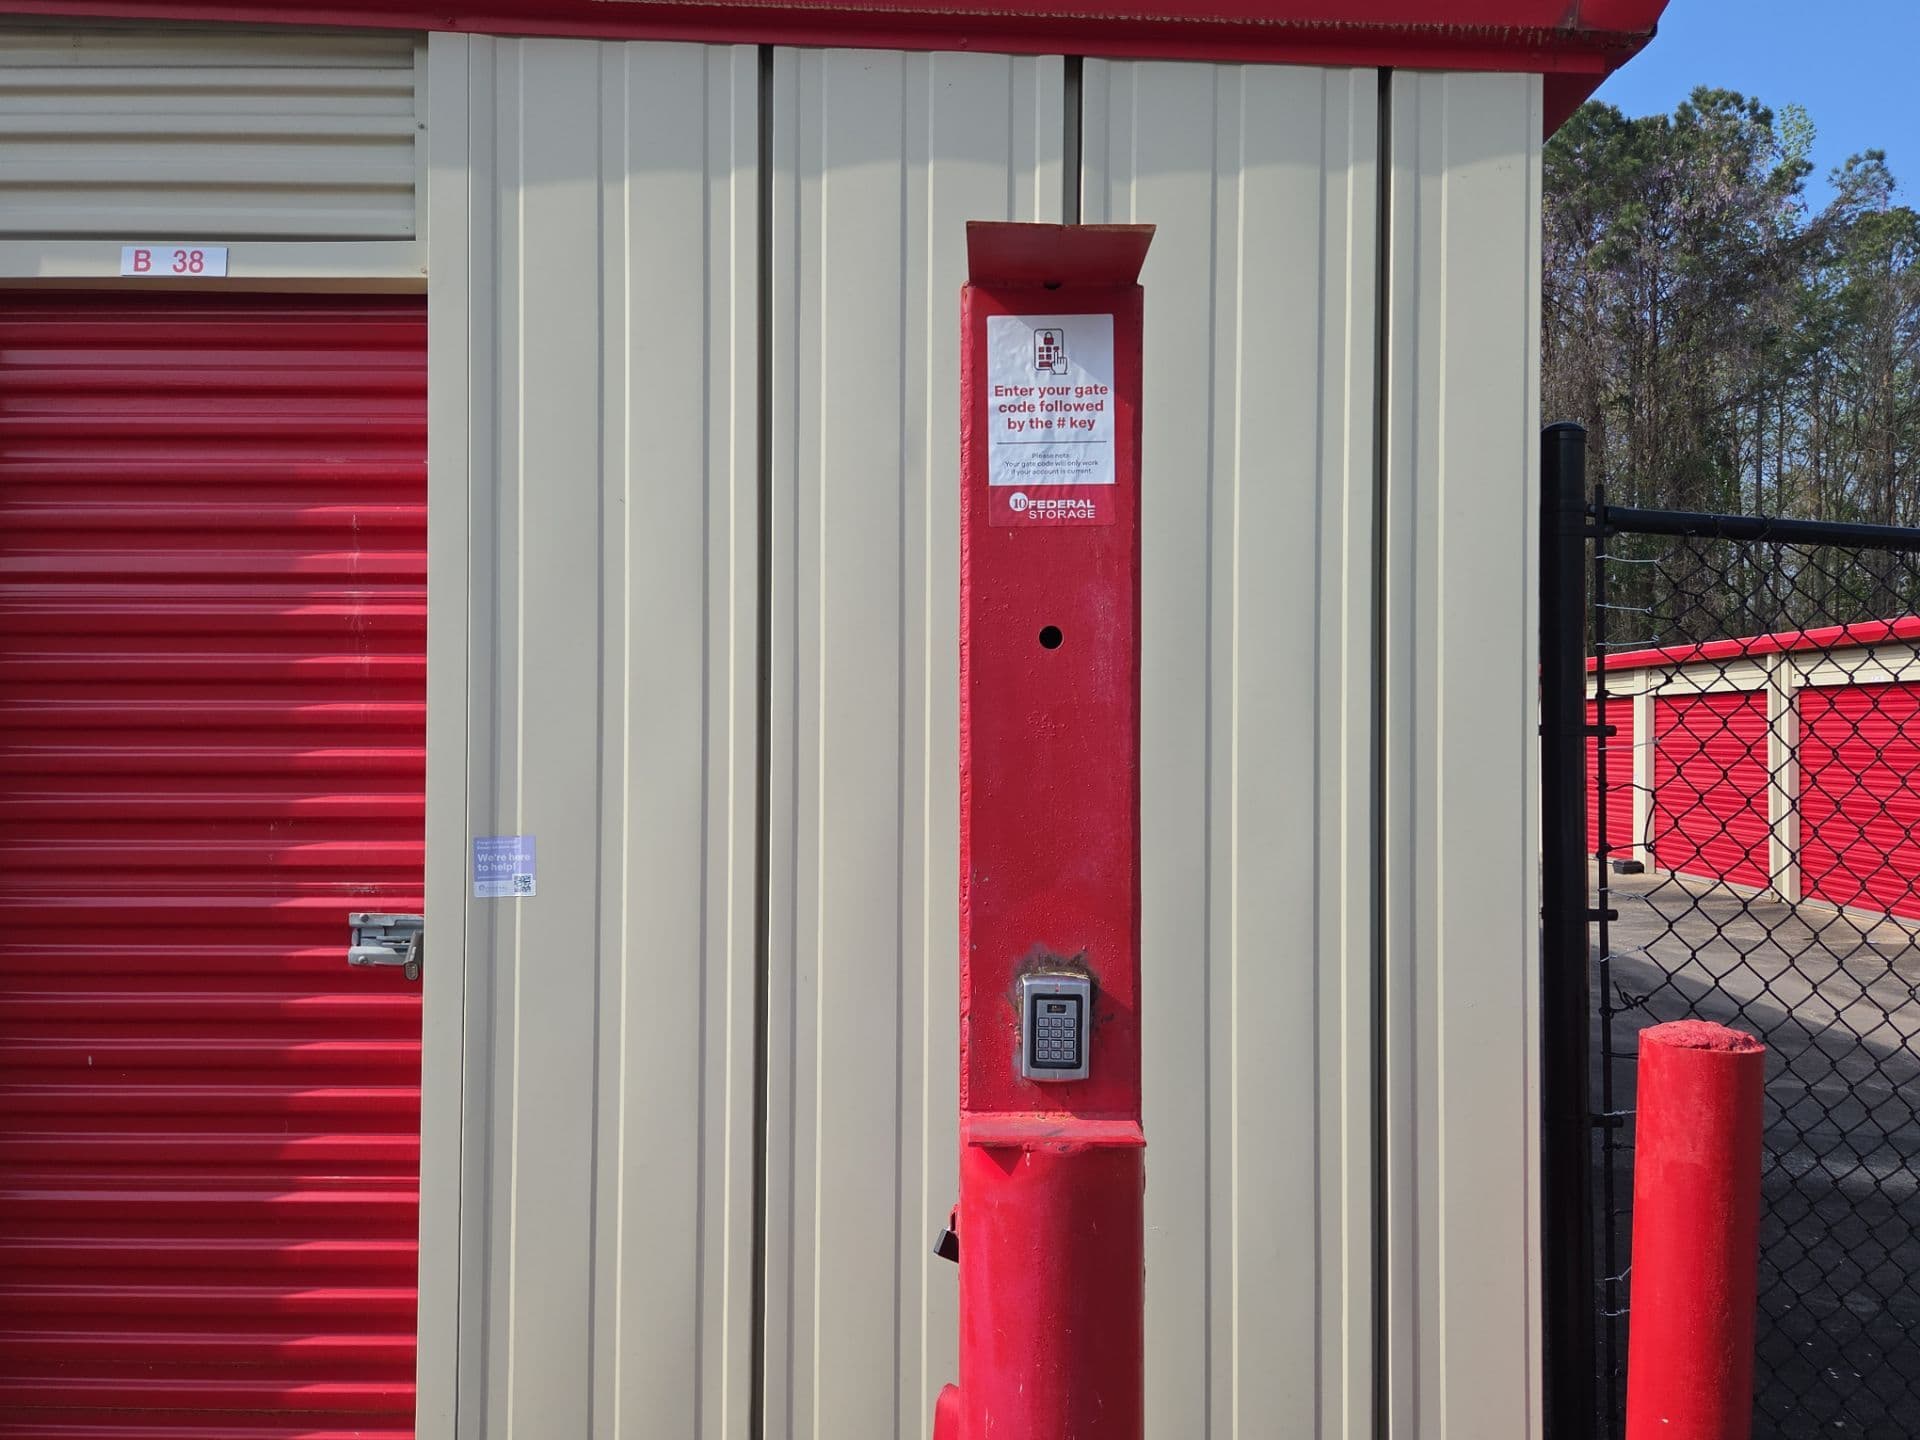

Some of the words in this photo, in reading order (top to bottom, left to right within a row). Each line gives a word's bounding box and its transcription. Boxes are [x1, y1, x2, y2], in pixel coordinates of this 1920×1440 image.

[134, 250, 151, 272] B
[172, 250, 204, 273] 38
[995, 385, 1034, 397] Enter
[1038, 386, 1071, 398] your
[1074, 384, 1108, 398] gate
[998, 401, 1035, 413] code
[1039, 400, 1104, 412] followed
[1007, 417, 1025, 432] by
[1029, 417, 1052, 429] the
[1057, 417, 1066, 429] #
[1069, 417, 1095, 431] key
[1067, 460, 1081, 468] only
[1029, 499, 1095, 509] FEDERAL
[1029, 509, 1095, 519] STORAGE
[478, 853, 507, 863] We're
[508, 853, 531, 862] here
[477, 864, 489, 872] to
